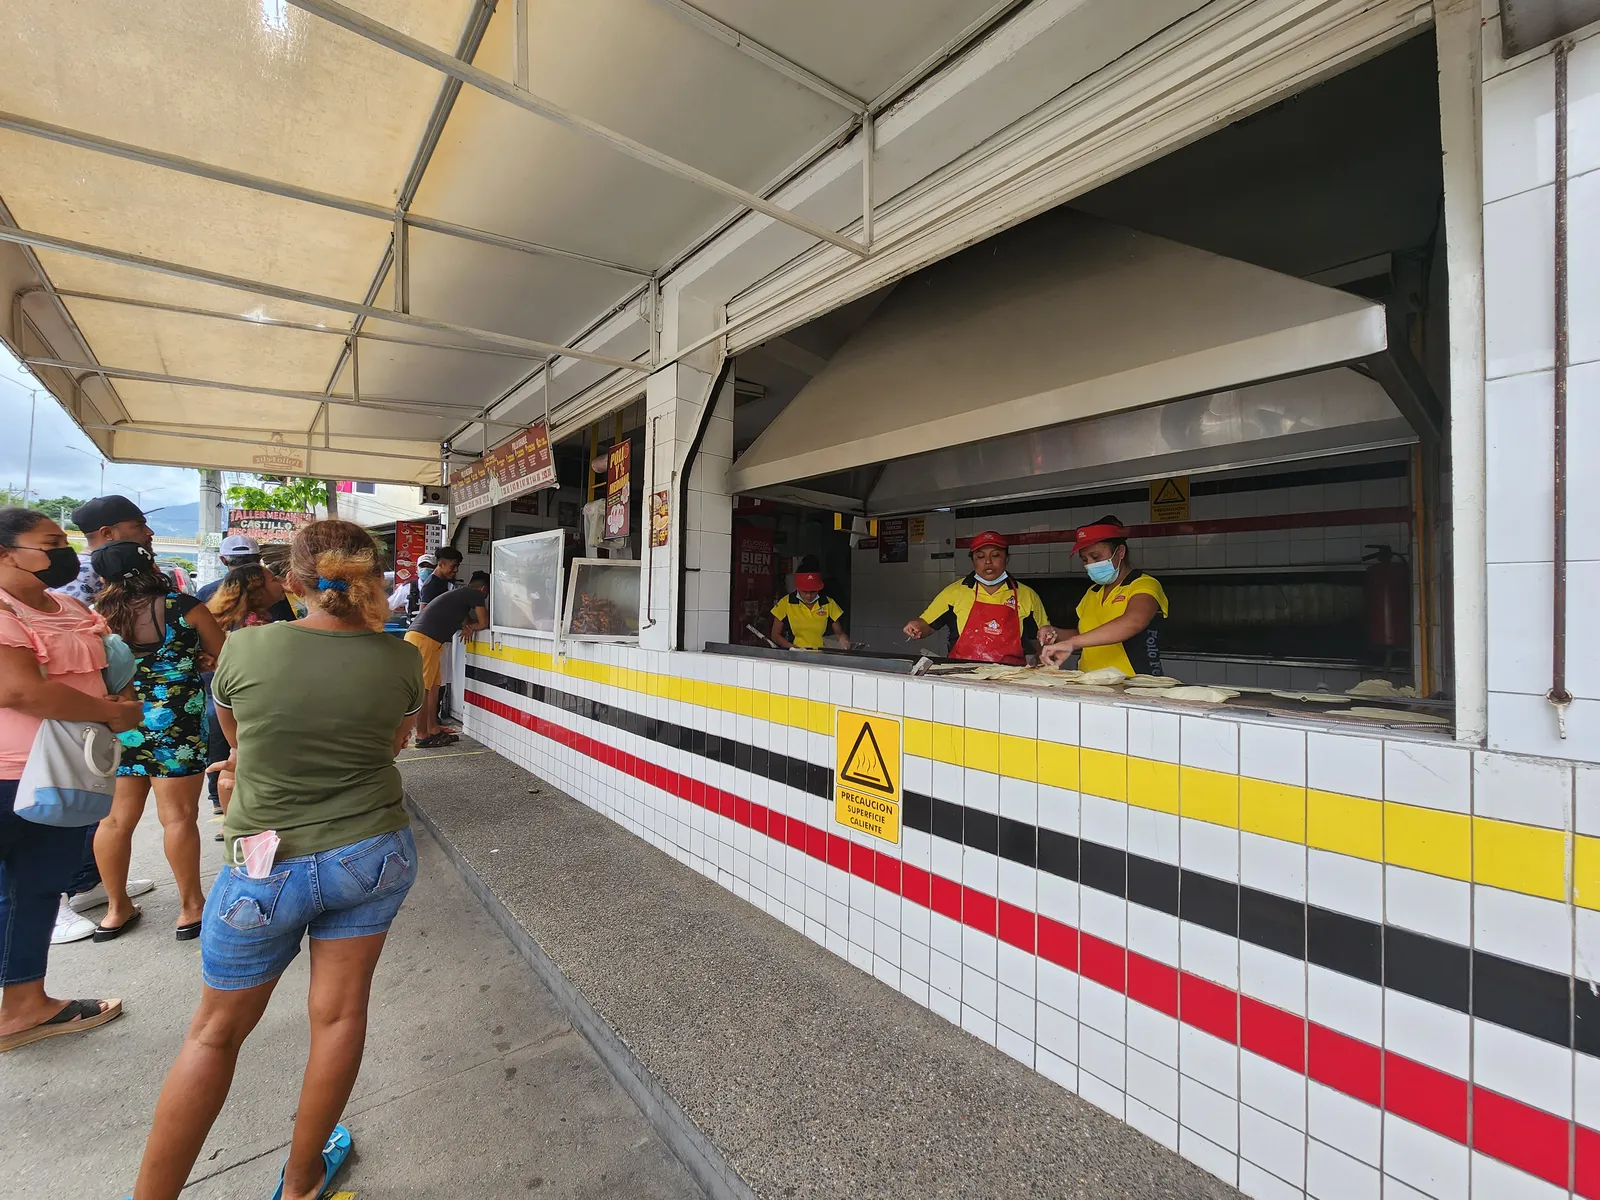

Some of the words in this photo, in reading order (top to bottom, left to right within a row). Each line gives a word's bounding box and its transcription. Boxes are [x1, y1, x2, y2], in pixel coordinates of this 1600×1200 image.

[230, 509, 266, 522] TALLER
[240, 520, 292, 530] CASTILLO
[741, 552, 771, 565] BIEN
[741, 564, 770, 575] FRÍA
[841, 791, 893, 815] PRECAUCION
[847, 804, 885, 824] SUPERFICIE
[850, 817, 882, 834] CALIENTE
